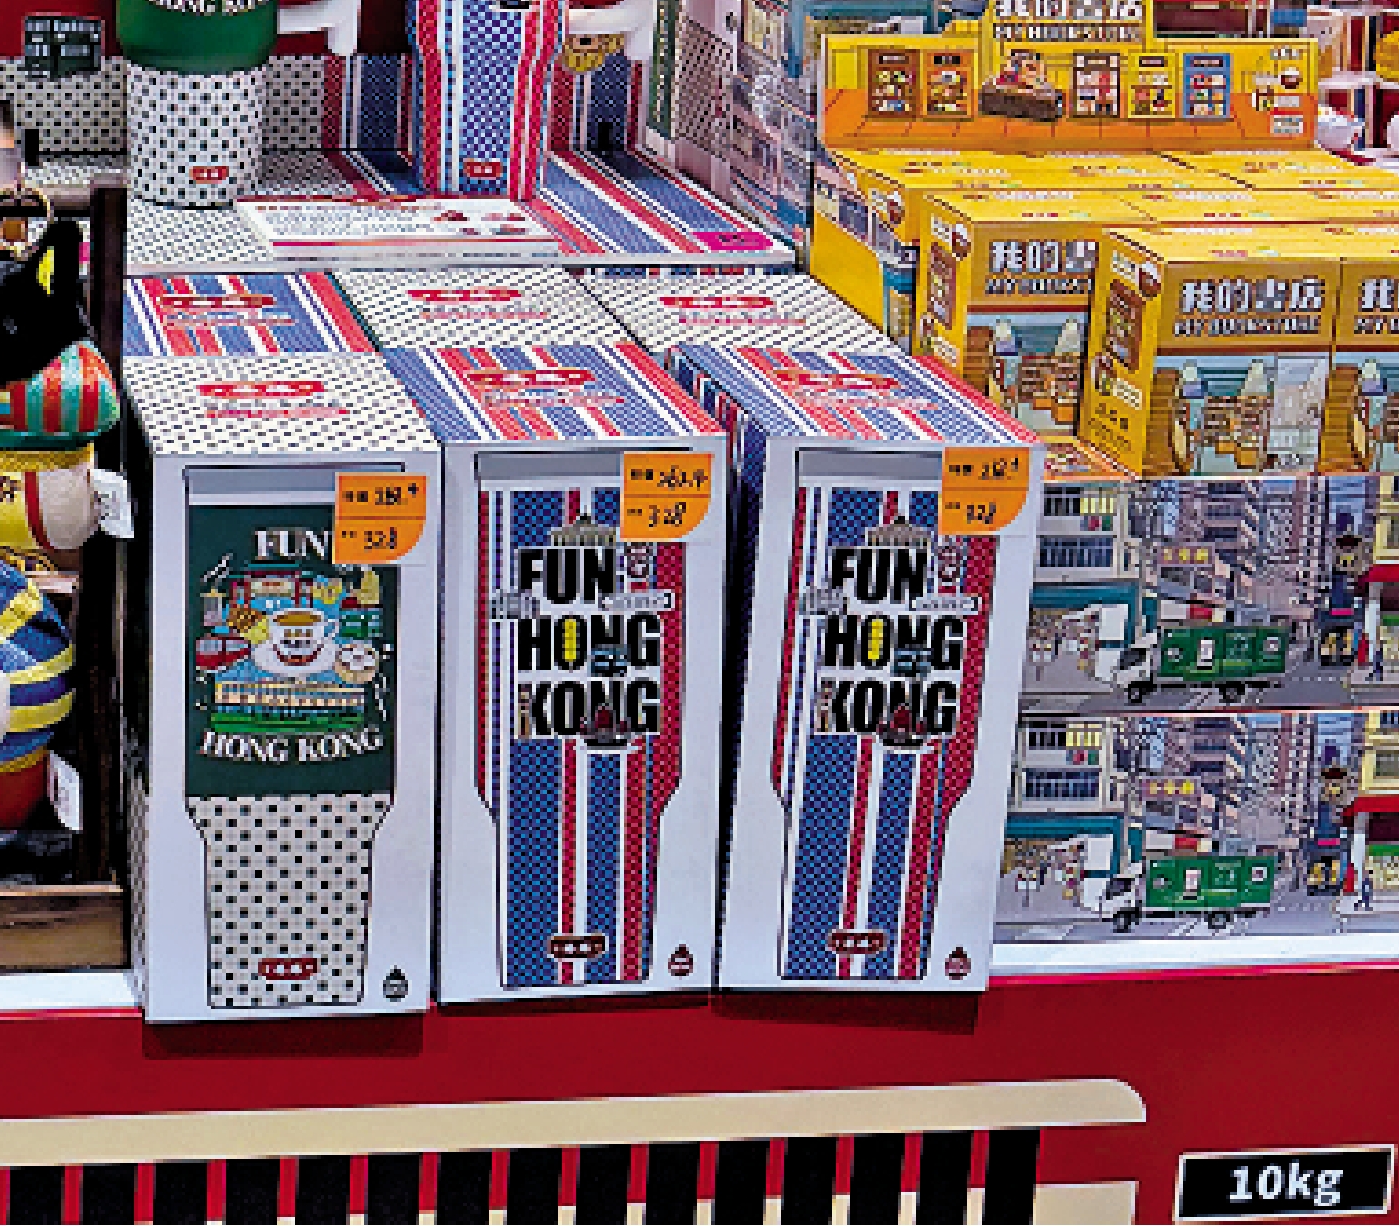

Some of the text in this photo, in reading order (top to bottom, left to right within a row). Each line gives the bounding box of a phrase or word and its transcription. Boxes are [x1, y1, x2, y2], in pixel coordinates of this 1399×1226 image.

[254, 527, 333, 561] FUN
[519, 547, 617, 604] FUN
[831, 547, 929, 604] FUN
[517, 614, 661, 672] HONG
[824, 614, 965, 672] HONG
[517, 681, 661, 736] KONG
[815, 680, 962, 736] KONG
[198, 725, 385, 764] HONG KONG
[1226, 1161, 1347, 1208] 10kg
